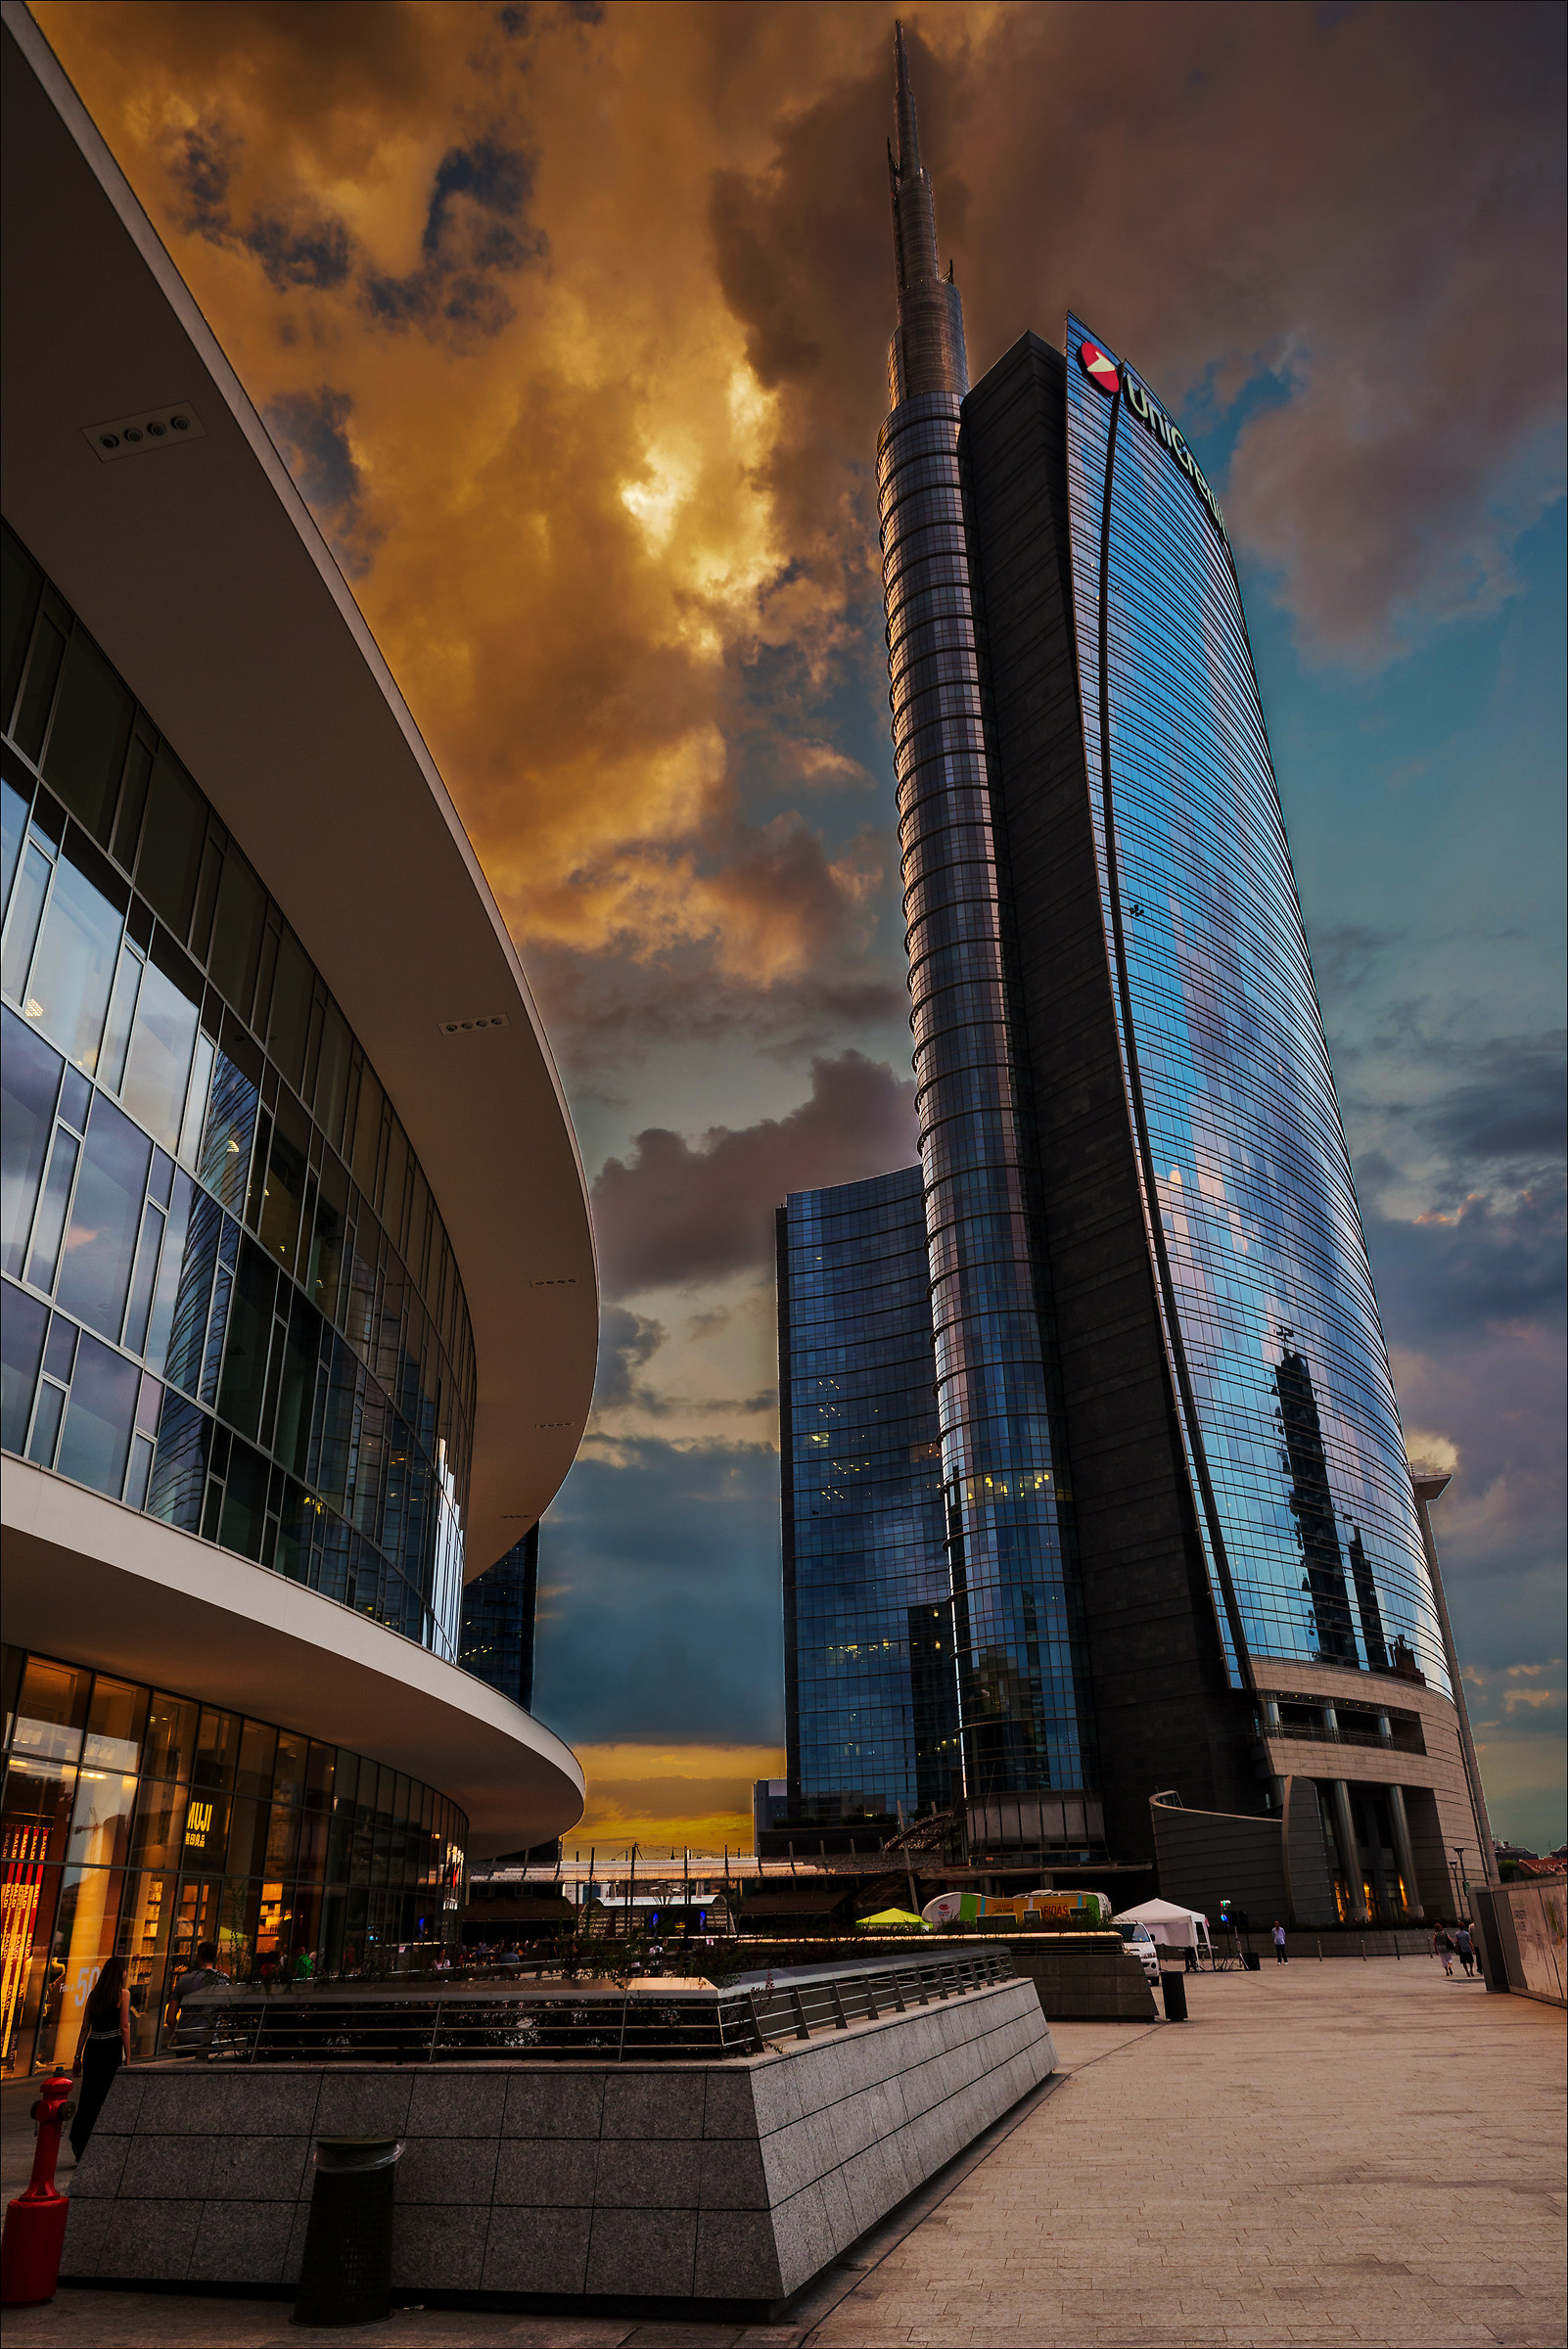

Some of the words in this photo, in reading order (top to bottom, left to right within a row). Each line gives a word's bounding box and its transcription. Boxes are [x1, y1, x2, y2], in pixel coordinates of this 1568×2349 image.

[11, 1833, 20, 1859] SALDI
[20, 1834, 28, 1859] SALDI
[29, 1835, 38, 1861] SALDI
[39, 1835, 48, 1861] SALDI
[11, 1883, 20, 1909] SALDI
[31, 1883, 40, 1909] SALDI
[24, 1932, 33, 1958] SALDI
